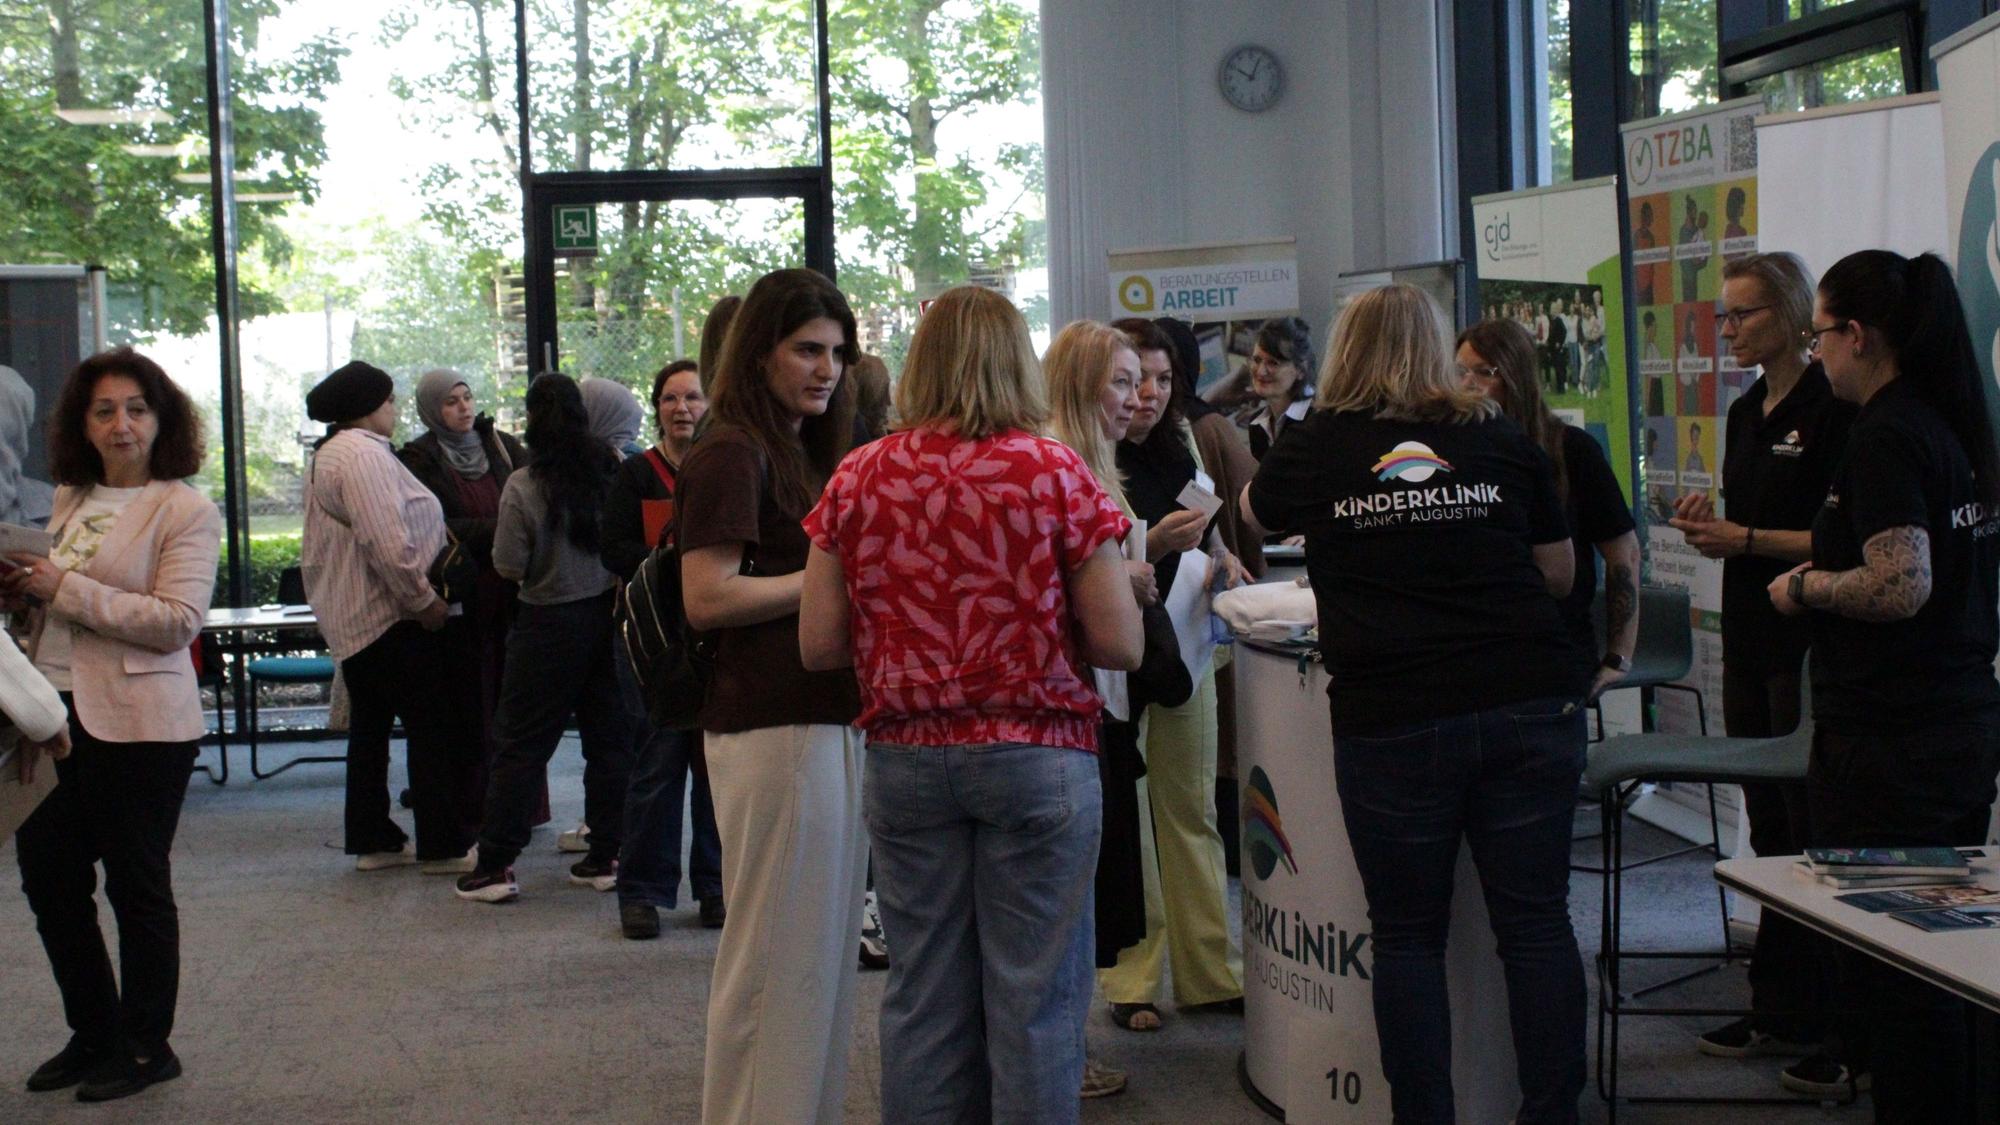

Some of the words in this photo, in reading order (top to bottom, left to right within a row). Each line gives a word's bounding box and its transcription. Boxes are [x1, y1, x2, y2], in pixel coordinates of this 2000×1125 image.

[1654, 124, 1714, 168] TZBA
[1485, 212, 1511, 252] cjd
[1160, 269, 1290, 289] BERATUNGSSTELLEN
[1162, 287, 1239, 311] ARBEIT
[1353, 512, 1403, 530] SANKT
[1410, 506, 1489, 523] AUGUSTIN
[1326, 1067, 1361, 1104] 10
